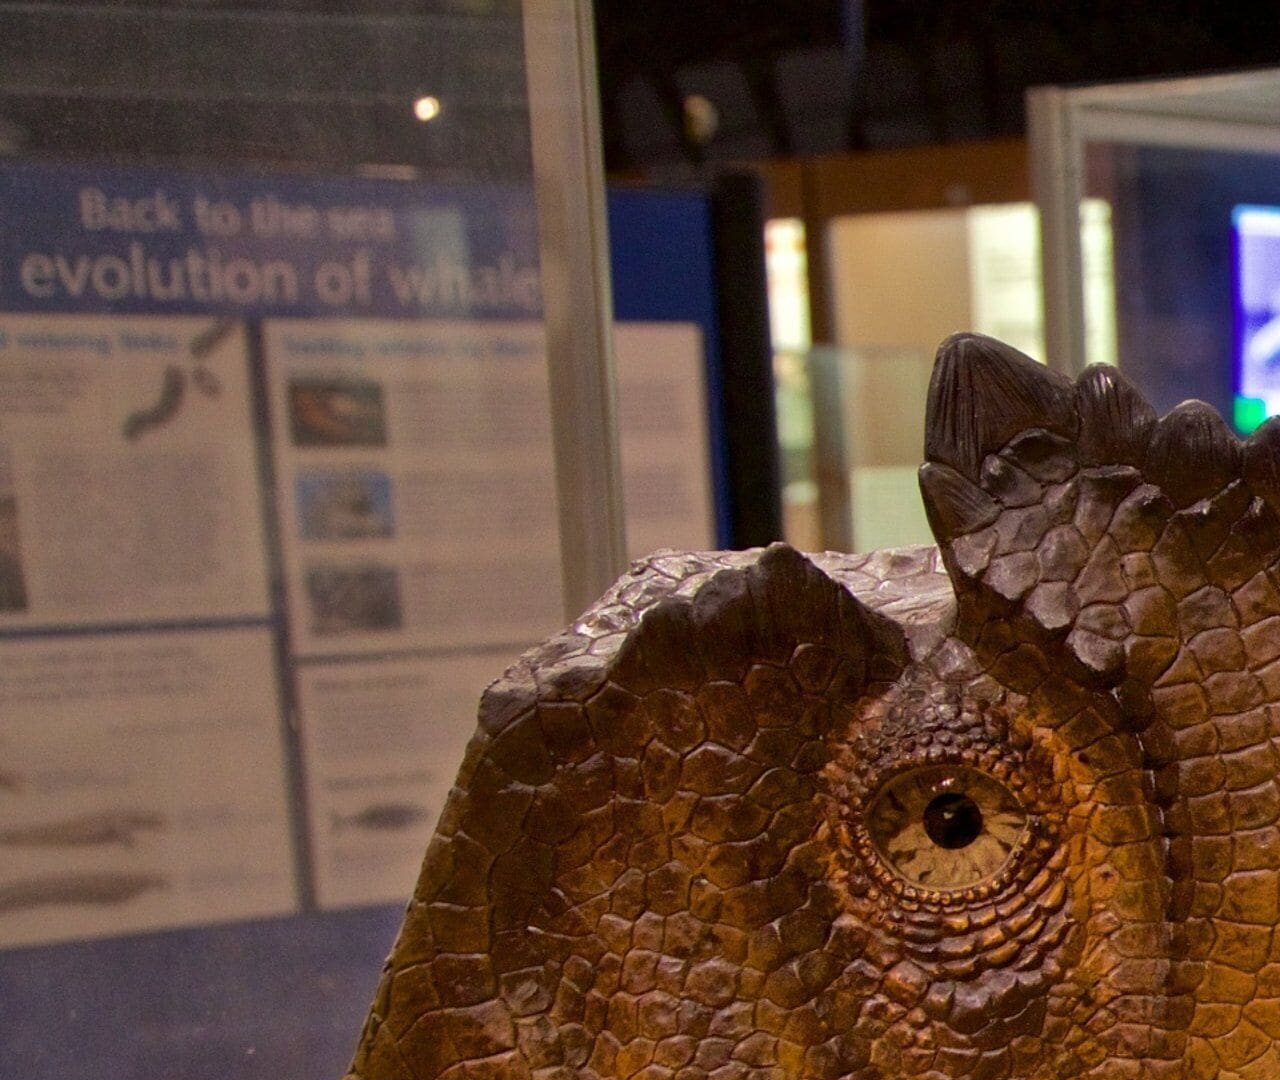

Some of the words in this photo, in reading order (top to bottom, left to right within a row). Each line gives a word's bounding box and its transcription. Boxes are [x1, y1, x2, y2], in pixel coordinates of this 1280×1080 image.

[80, 187, 180, 231] Back
[195, 190, 241, 235] to
[250, 194, 318, 238] the
[20, 240, 297, 303] evolution
[314, 252, 371, 303] of
